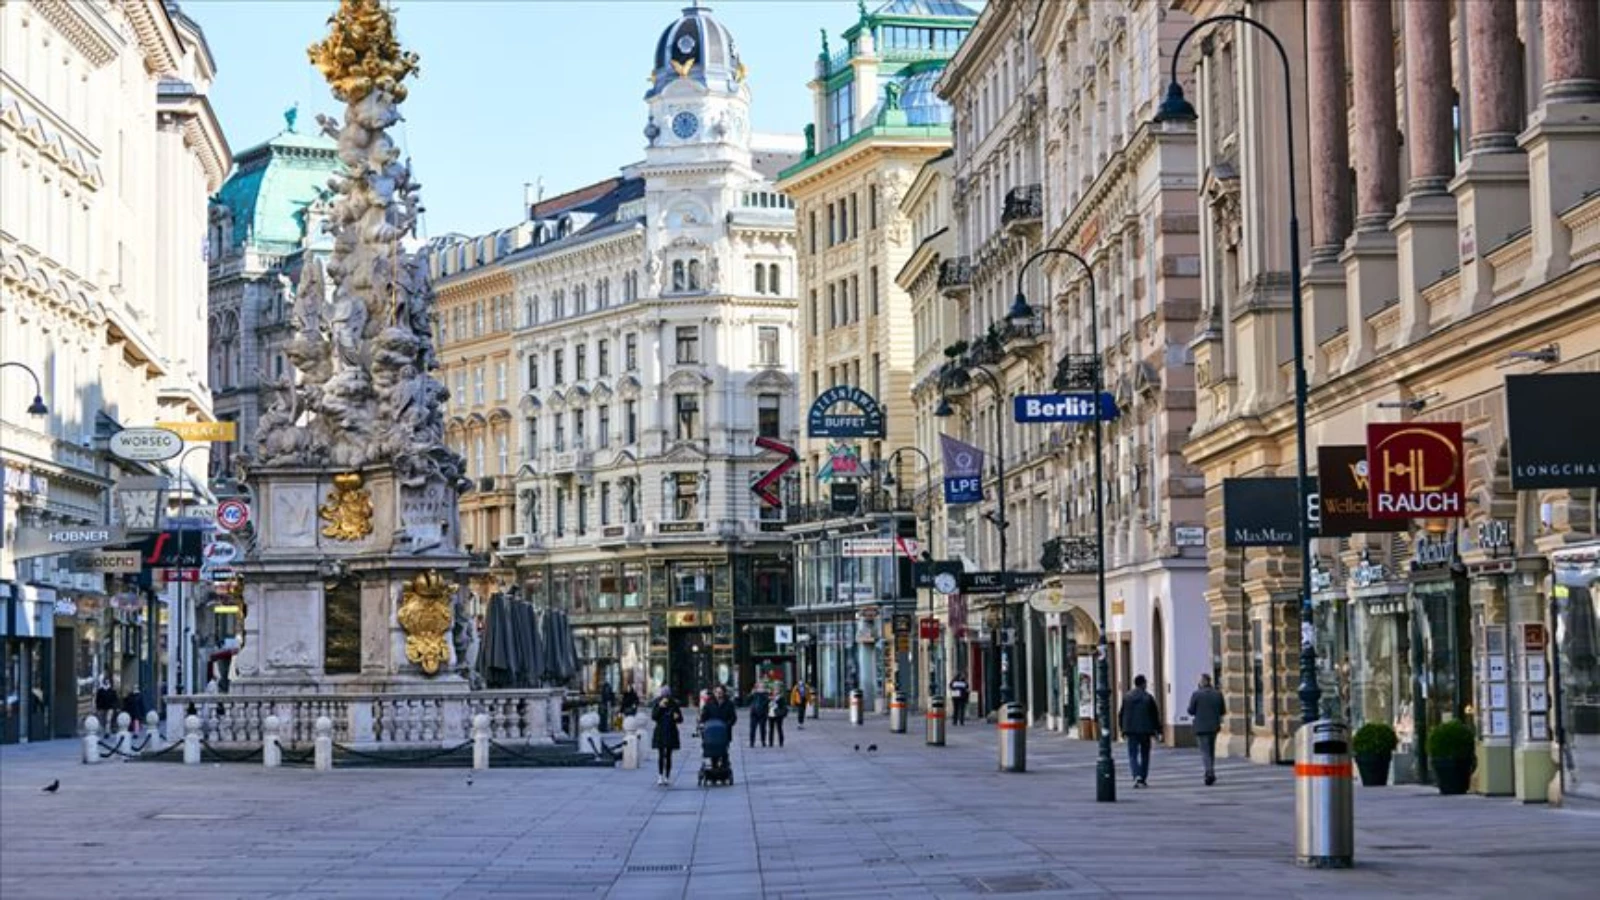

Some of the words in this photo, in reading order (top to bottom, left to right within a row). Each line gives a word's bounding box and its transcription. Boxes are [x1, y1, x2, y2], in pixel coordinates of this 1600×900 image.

[824, 417, 866, 428] BUFFET
[1517, 463, 1600, 477] LONGCHA
[950, 478, 979, 493] LPE
[1325, 497, 1369, 513] Wellen
[1377, 491, 1459, 513] RAUCH
[1235, 528, 1294, 542] MaxMara
